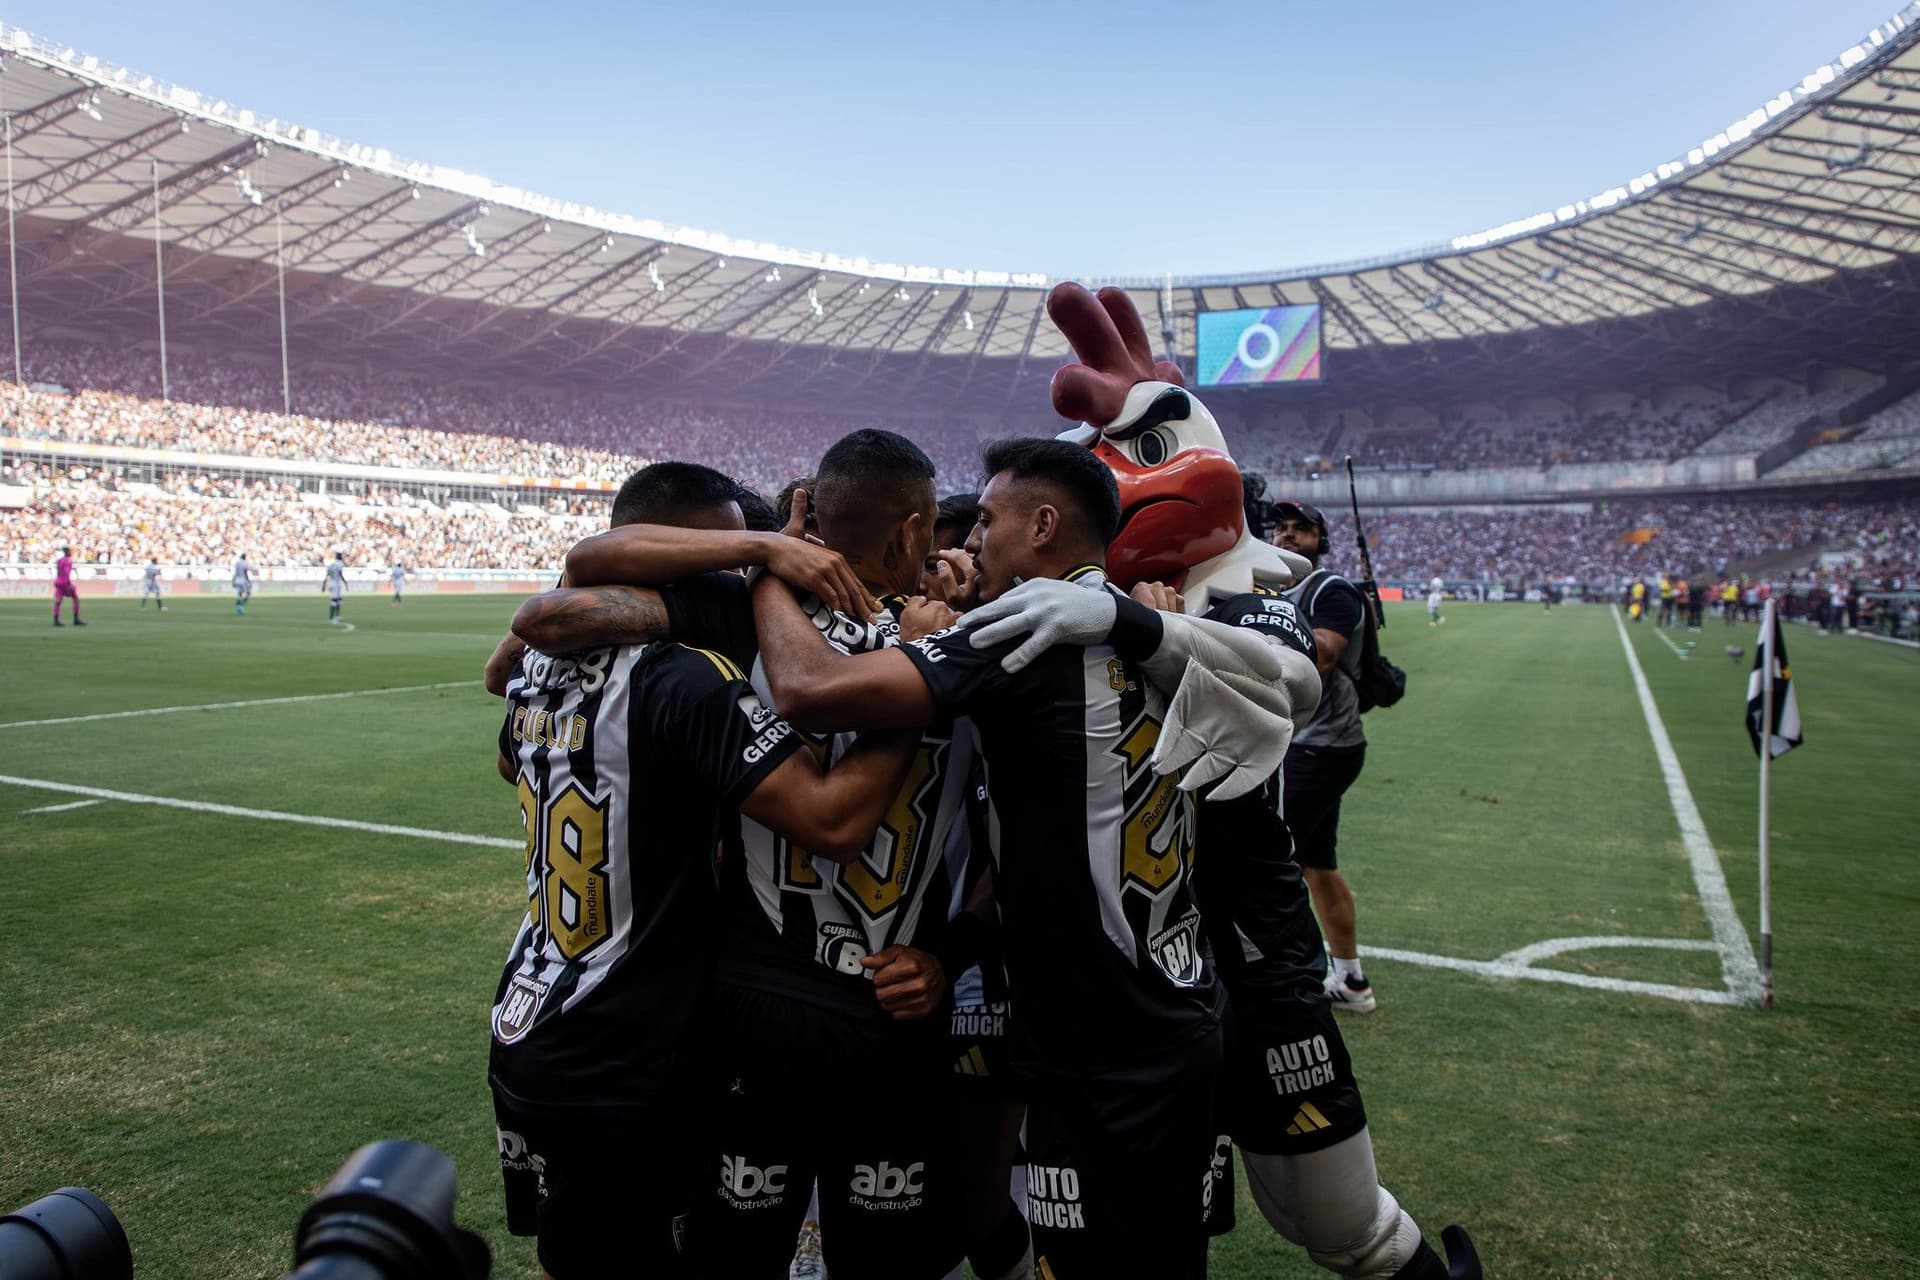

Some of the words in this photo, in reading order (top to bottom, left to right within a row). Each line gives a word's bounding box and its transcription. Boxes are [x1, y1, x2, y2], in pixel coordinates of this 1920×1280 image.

[906, 638, 948, 663] DAU
[1240, 613, 1313, 651] GERDAU
[513, 706, 587, 752] CUELLO
[743, 721, 792, 763] GERD
[584, 877, 599, 936] mundiale
[1162, 931, 1190, 978] BH
[502, 990, 535, 1029] BH
[1266, 1034, 1330, 1075] AUTO
[1271, 1061, 1336, 1096] TRUCK
[720, 1153, 789, 1198] abc
[850, 1161, 925, 1198] abc
[1027, 1162, 1080, 1201] AUTO
[1028, 1196, 1086, 1229] TRUCK
